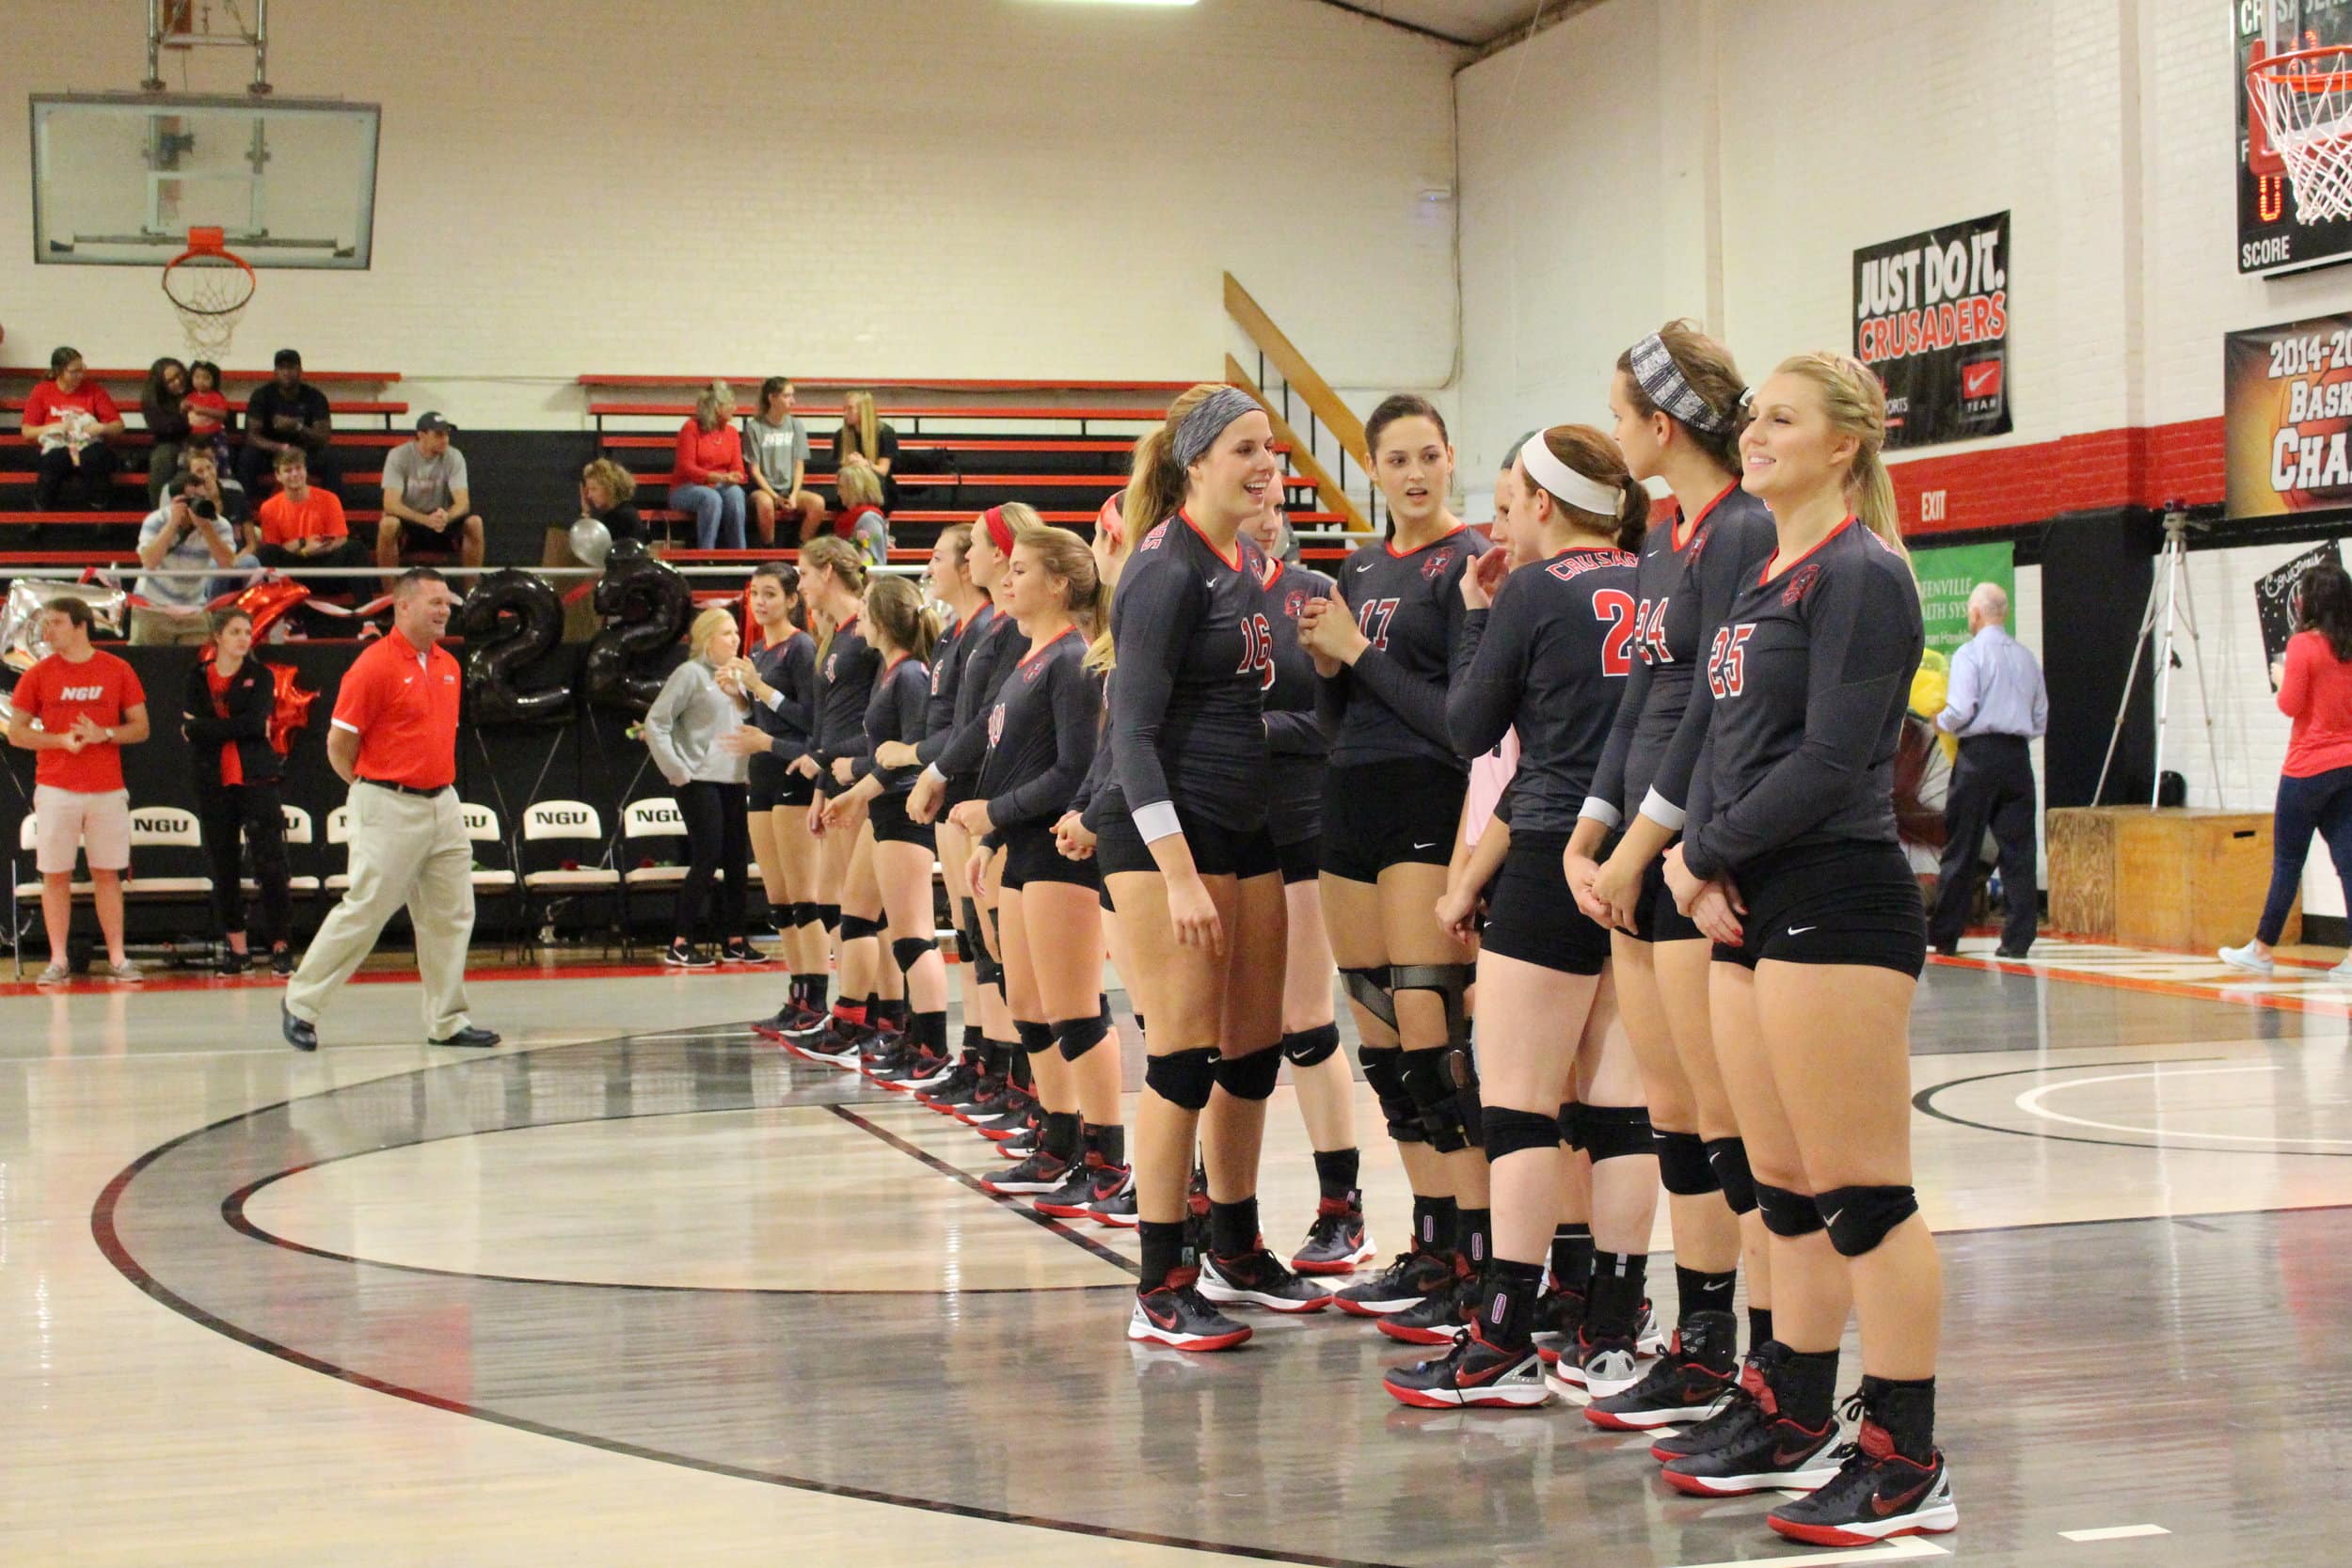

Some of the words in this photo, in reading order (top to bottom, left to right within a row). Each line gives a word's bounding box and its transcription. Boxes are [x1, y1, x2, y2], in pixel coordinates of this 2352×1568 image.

[1858, 248, 1921, 320] JUST
[1924, 239, 1968, 306] DO
[1970, 229, 2006, 295] IT.
[2242, 235, 2291, 269] SCORE
[1859, 291, 2007, 365] CRUSADERS
[1966, 398, 1997, 413] TEAM
[2270, 427, 2352, 494] CHA
[1921, 489, 1947, 522] EXIT
[1235, 612, 1273, 674] 16
[1359, 597, 1401, 652] 17
[1592, 588, 1635, 677] 2
[1708, 623, 1757, 700] 25
[60, 686, 104, 701] NGU
[134, 818, 189, 833] NGU
[535, 811, 588, 825] NGU
